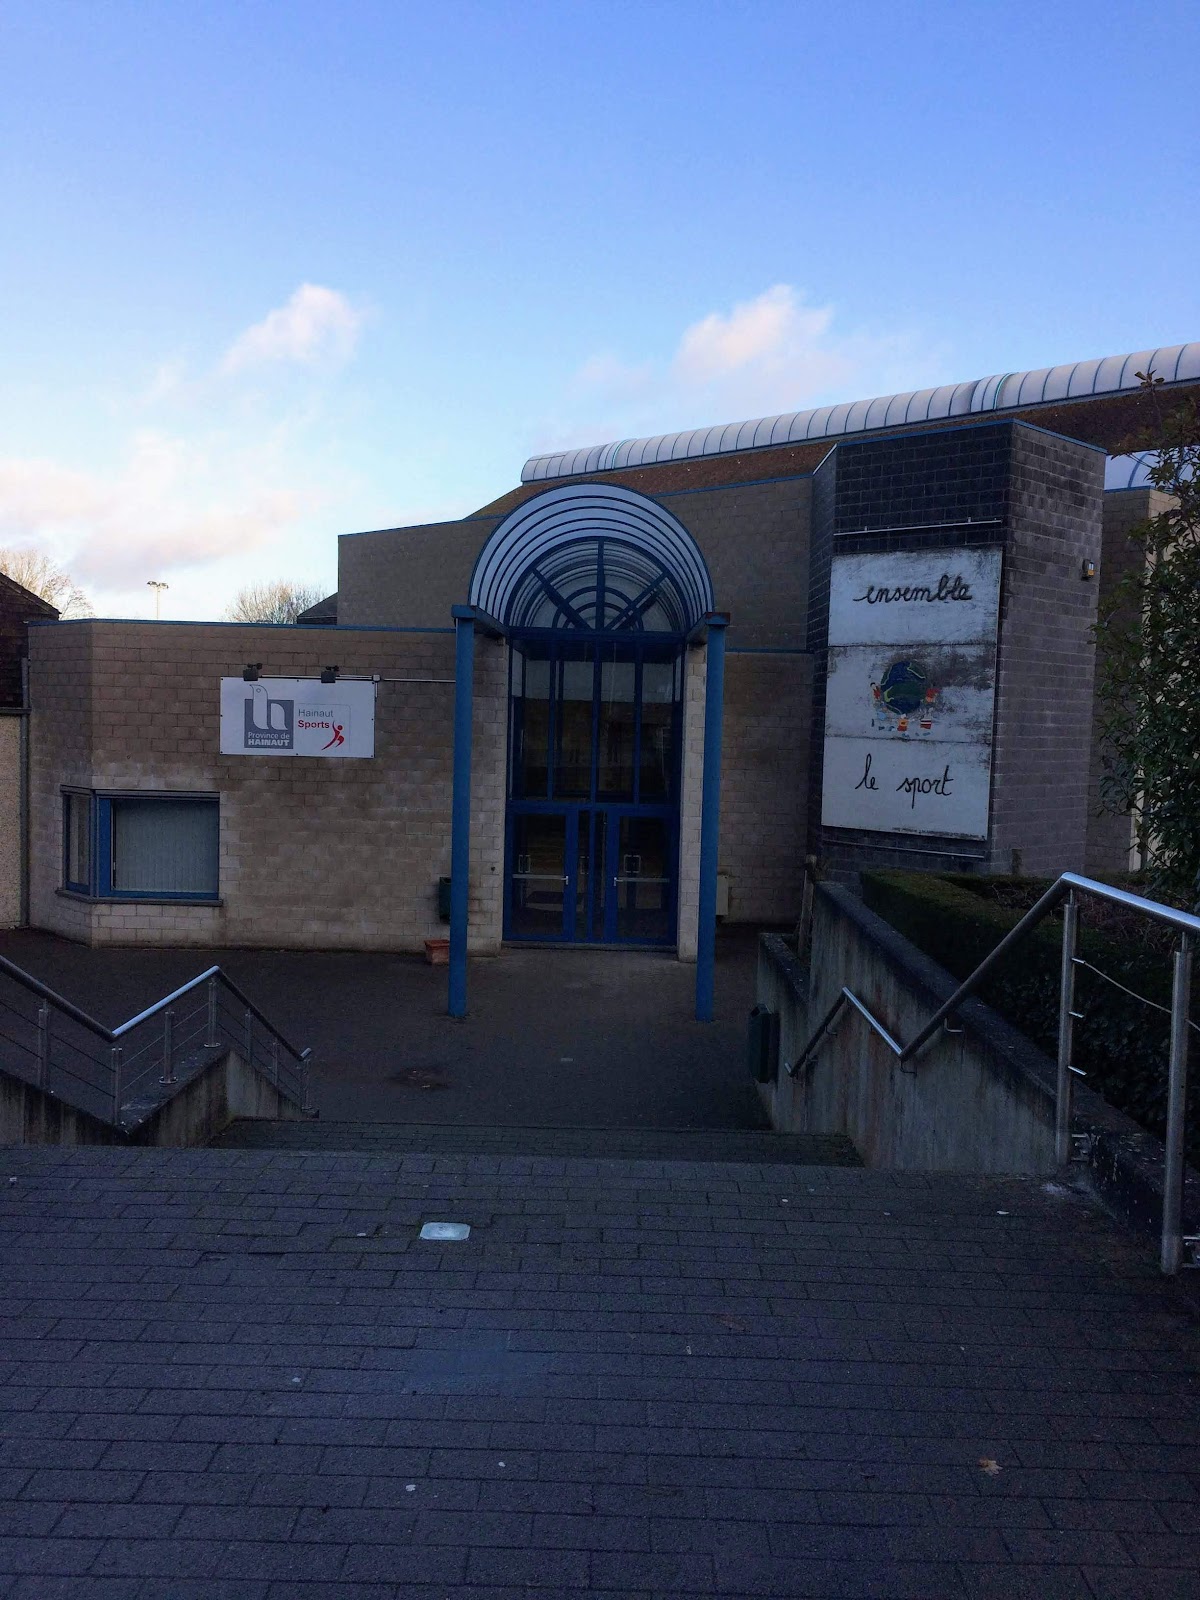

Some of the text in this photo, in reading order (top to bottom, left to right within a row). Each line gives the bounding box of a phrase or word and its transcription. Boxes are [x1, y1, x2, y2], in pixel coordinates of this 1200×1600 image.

[852, 574, 973, 604] ensemble
[298, 709, 334, 718] Hainaut
[298, 720, 330, 729] Sports
[248, 731, 290, 740] Province de
[248, 739, 290, 747] HAINAUT
[855, 754, 954, 809] le sport
